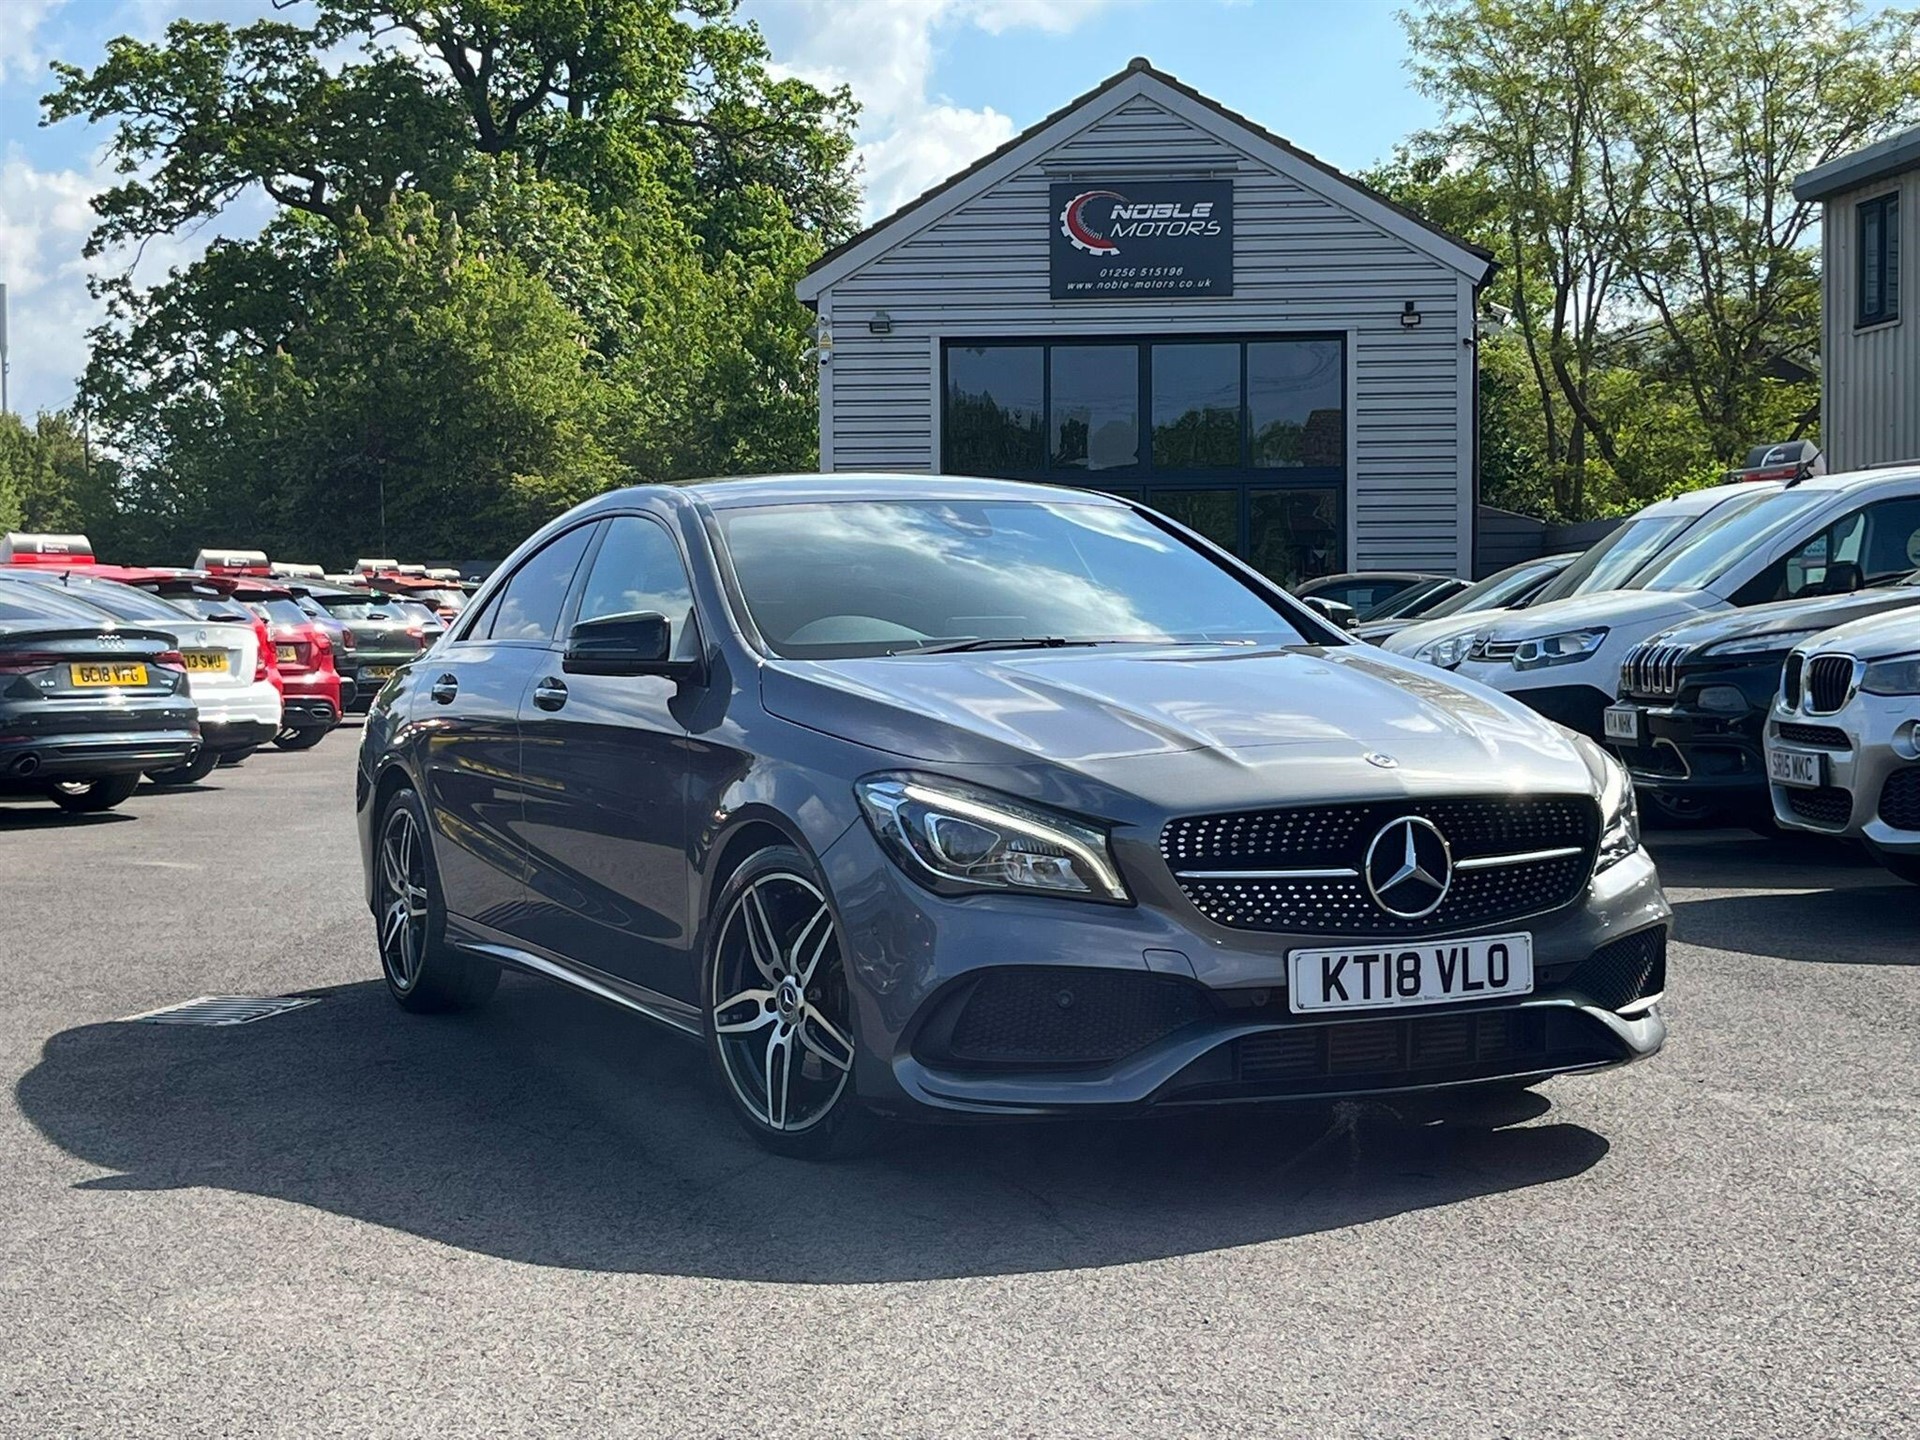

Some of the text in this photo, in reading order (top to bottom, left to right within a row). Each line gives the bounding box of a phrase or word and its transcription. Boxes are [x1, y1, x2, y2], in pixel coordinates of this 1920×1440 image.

[1110, 202, 1214, 220] NOBLE
[1110, 220, 1222, 238] MOTORS
[1100, 266, 1184, 278] 01256 515196
[1321, 943, 1509, 1002] KT18 VLO
